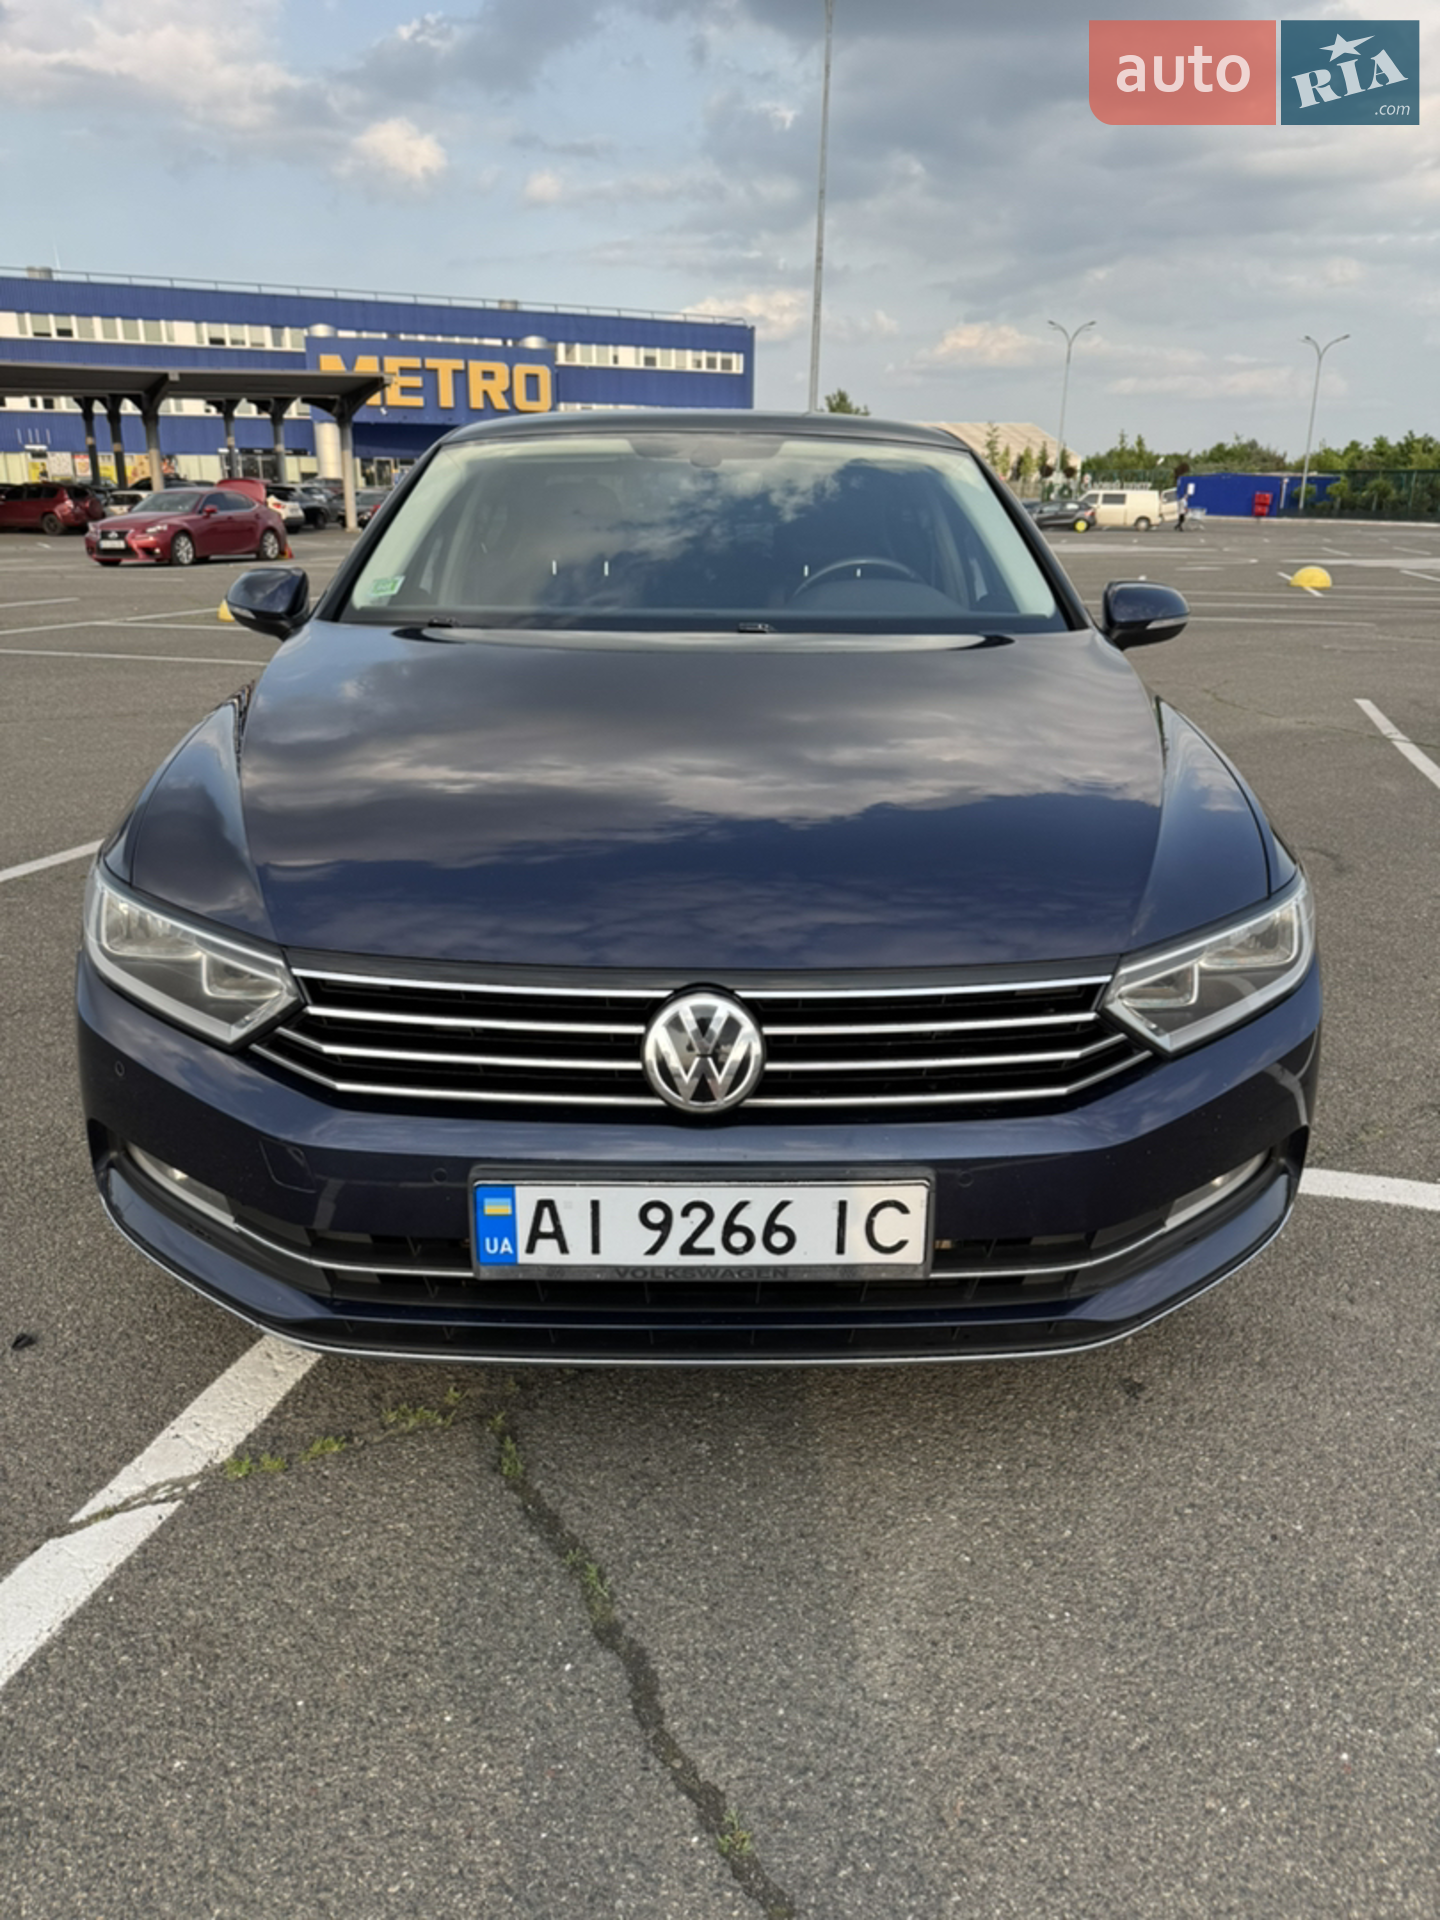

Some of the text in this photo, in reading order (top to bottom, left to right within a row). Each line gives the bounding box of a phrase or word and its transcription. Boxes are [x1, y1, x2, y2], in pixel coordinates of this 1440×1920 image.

[525, 1199, 911, 1256] AI 9266 IC
[484, 1237, 513, 1255] UA
[615, 1266, 790, 1279] VOLKSWAGEN
